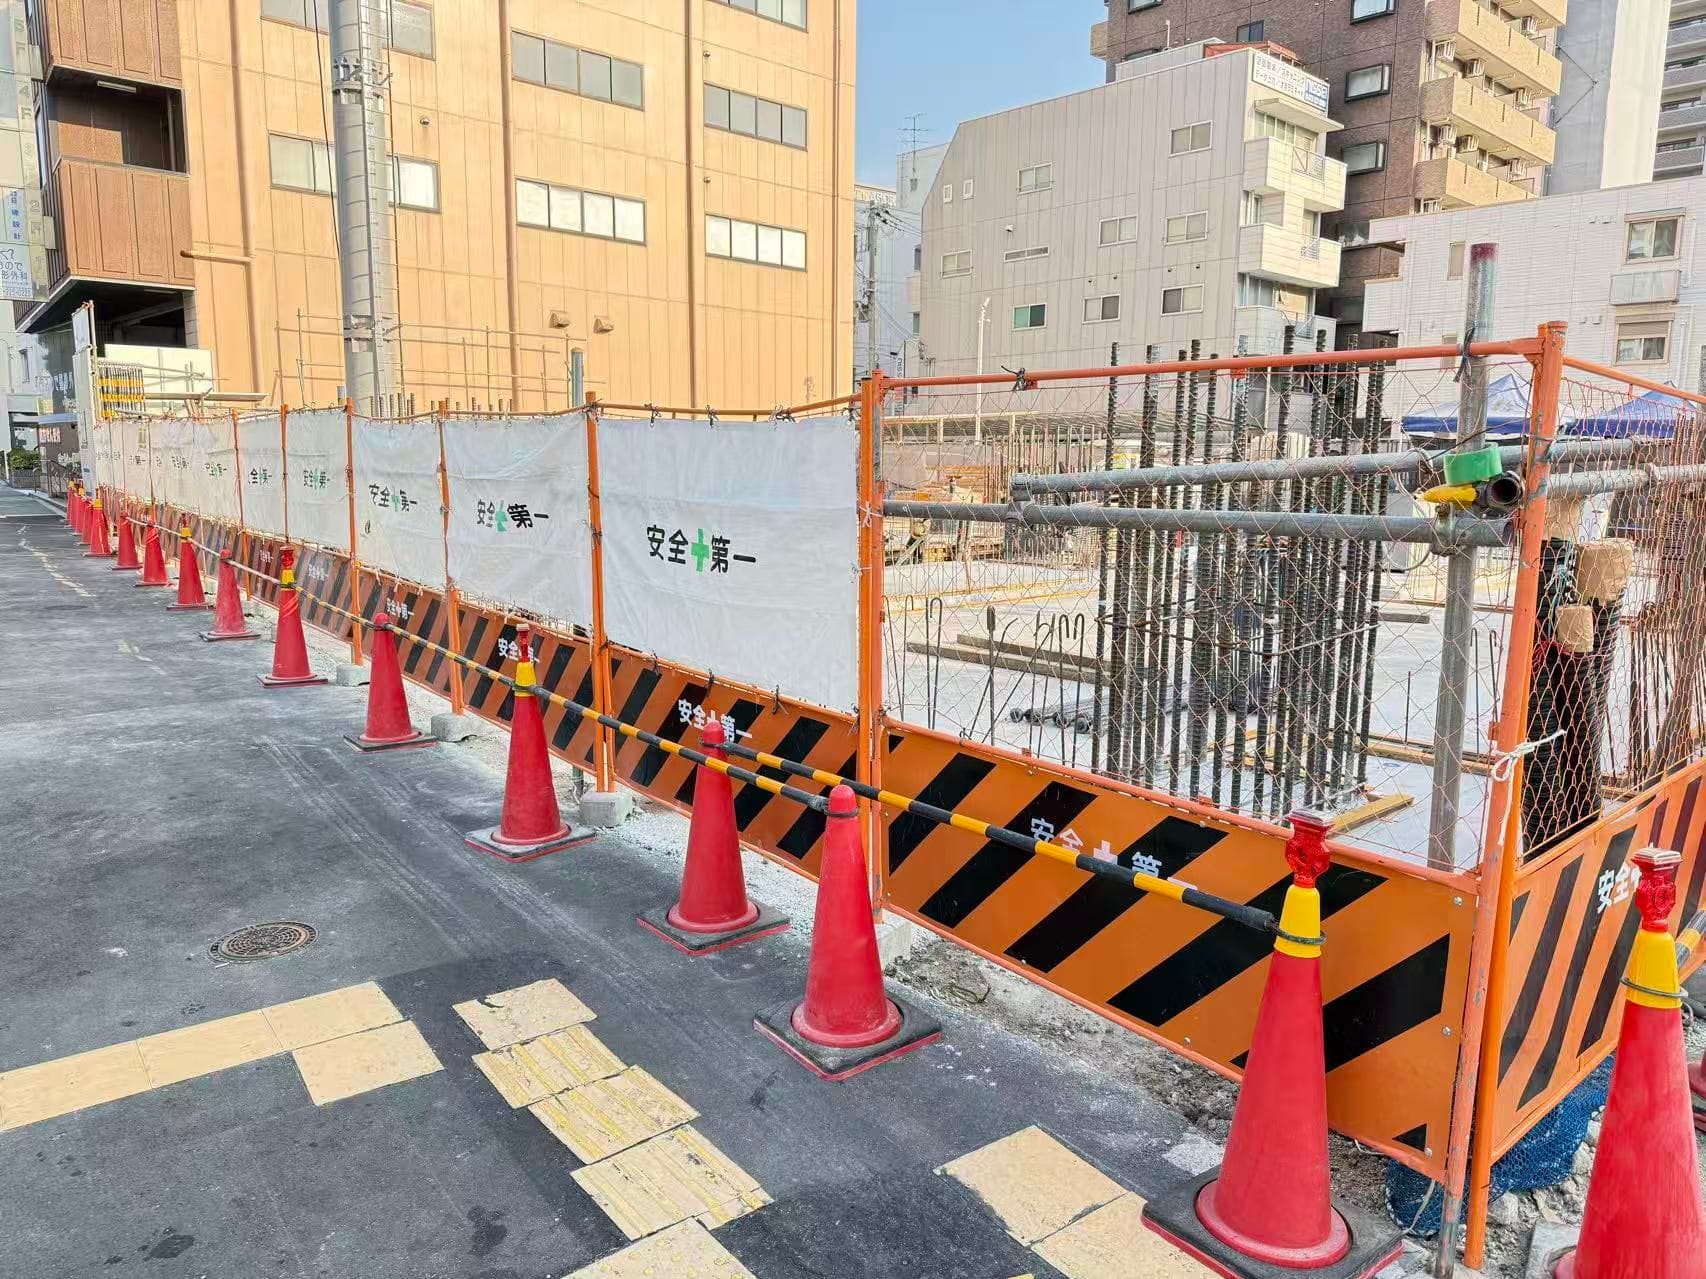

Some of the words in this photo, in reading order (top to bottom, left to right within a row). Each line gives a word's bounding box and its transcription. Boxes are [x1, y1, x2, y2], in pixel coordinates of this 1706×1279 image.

[368, 484, 417, 511] 安全第一
[476, 498, 550, 532] 安全第一
[646, 524, 758, 574] 安全第一
